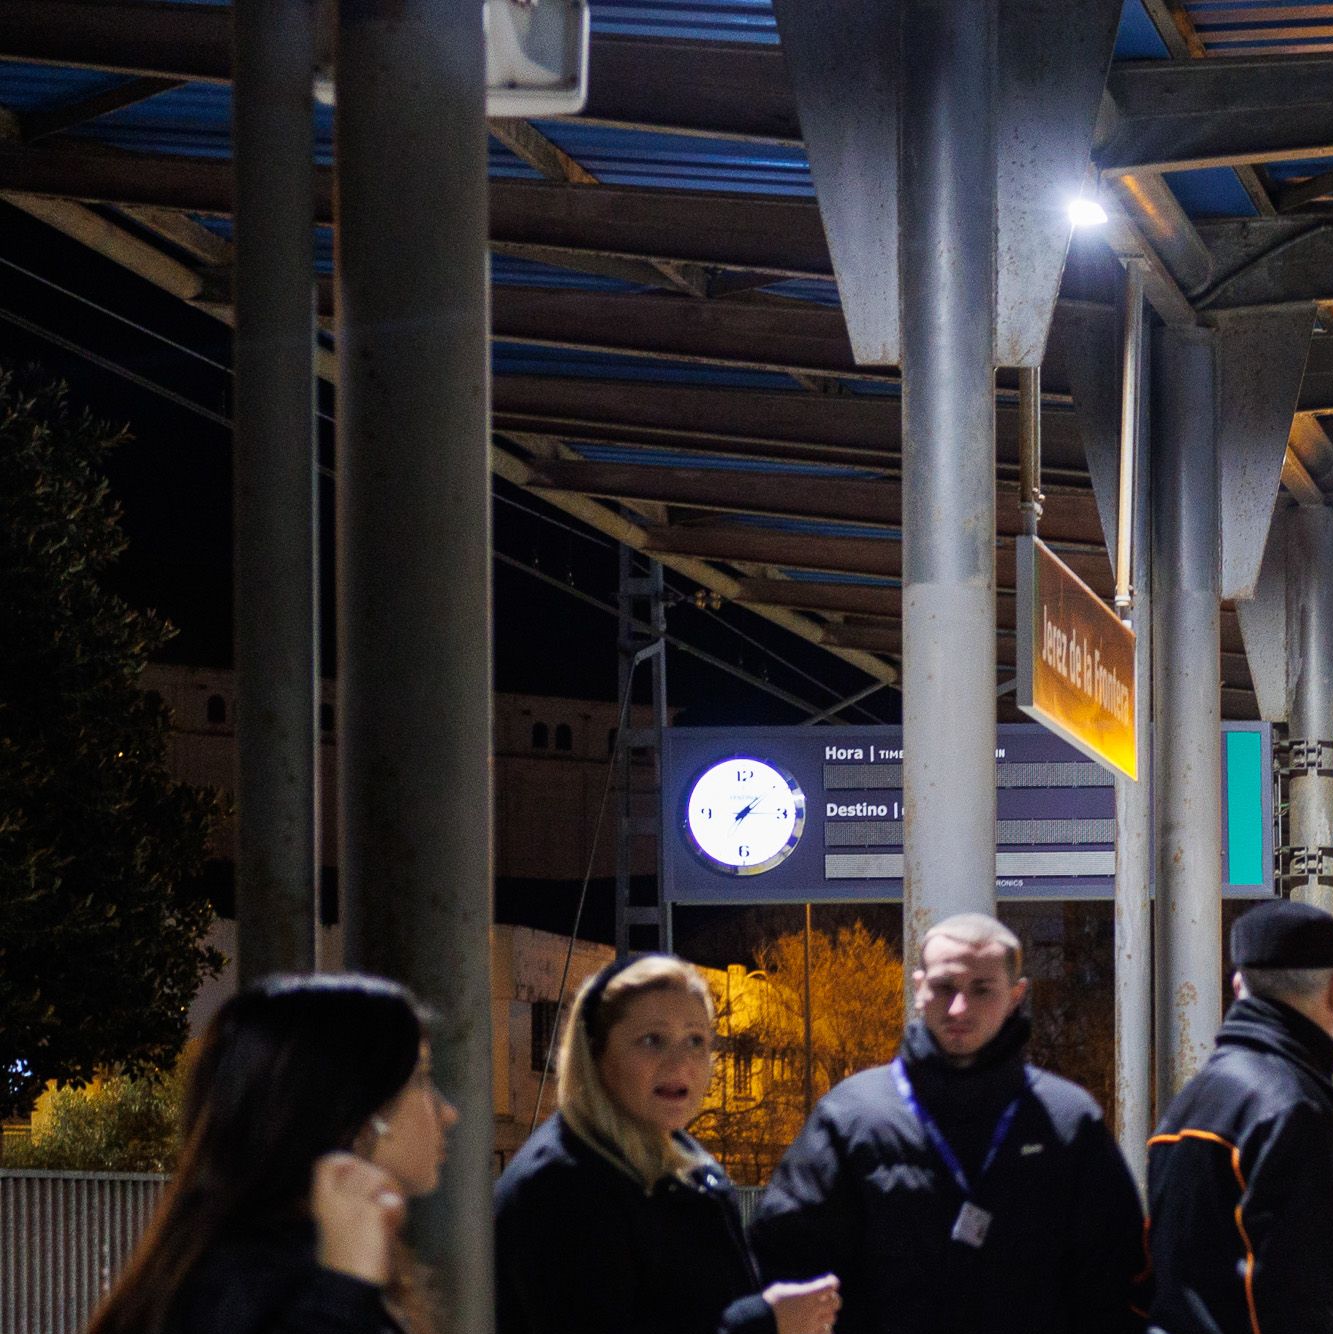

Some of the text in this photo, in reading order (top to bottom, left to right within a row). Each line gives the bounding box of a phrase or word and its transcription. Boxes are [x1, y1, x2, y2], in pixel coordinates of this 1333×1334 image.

[1042, 604, 1129, 726] Jerez de la Frontera
[825, 746, 863, 760] Hora
[826, 802, 887, 817] Destino
